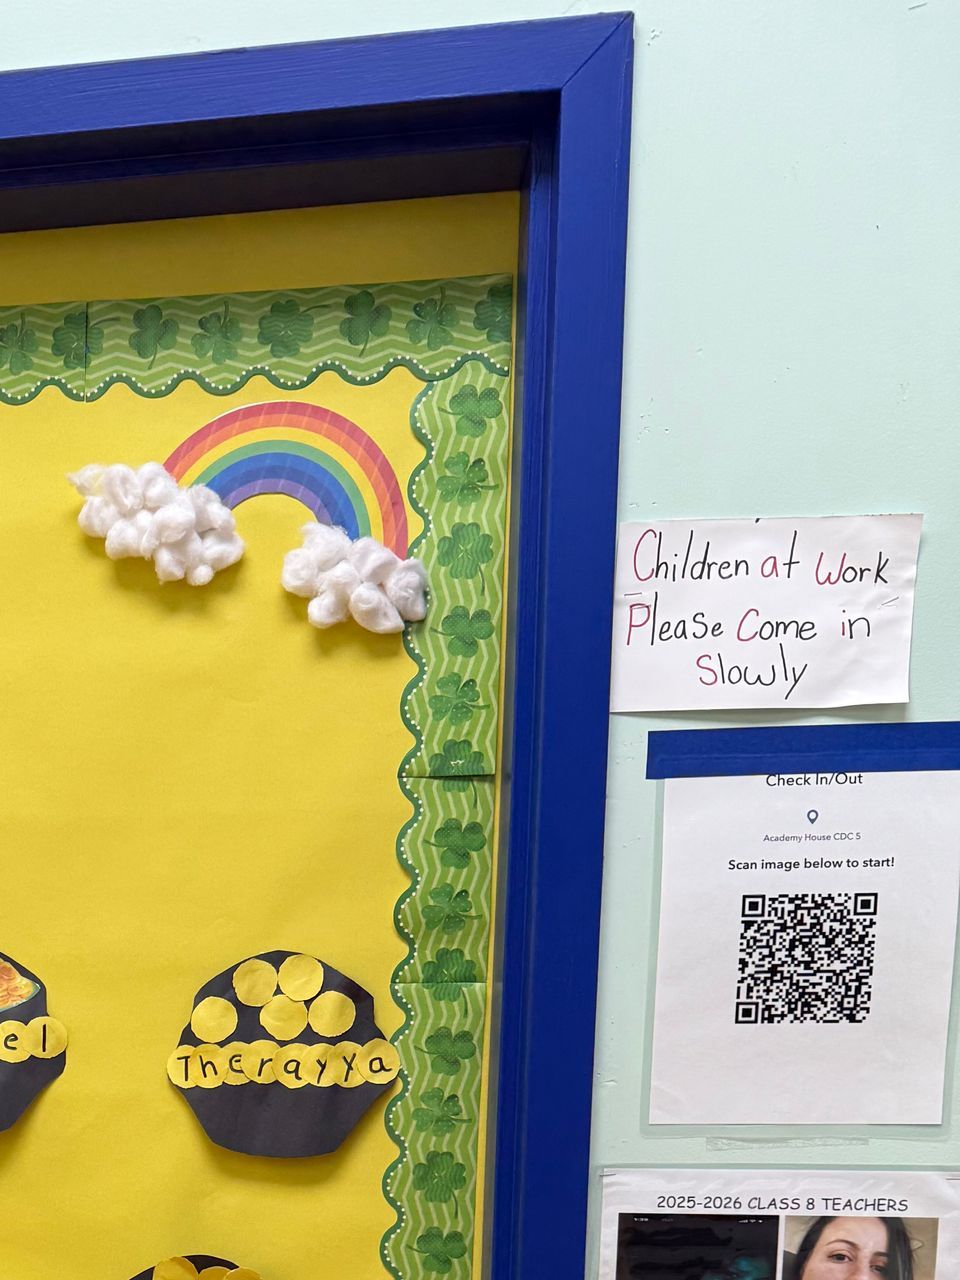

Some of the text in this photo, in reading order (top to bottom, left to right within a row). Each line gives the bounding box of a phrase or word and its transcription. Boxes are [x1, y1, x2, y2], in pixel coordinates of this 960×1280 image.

[634, 529, 889, 585] Children at Work
[627, 592, 871, 645] Please Come in
[696, 643, 808, 700] Slowly
[765, 772, 864, 787] Check In/Out
[763, 832, 861, 844] Academy House CDC 5
[728, 856, 895, 872] Scan image below to start!
[176, 1053, 393, 1084] Therayya
[656, 1195, 909, 1212] 2025-2026 CLASS 8 TEACHERS
